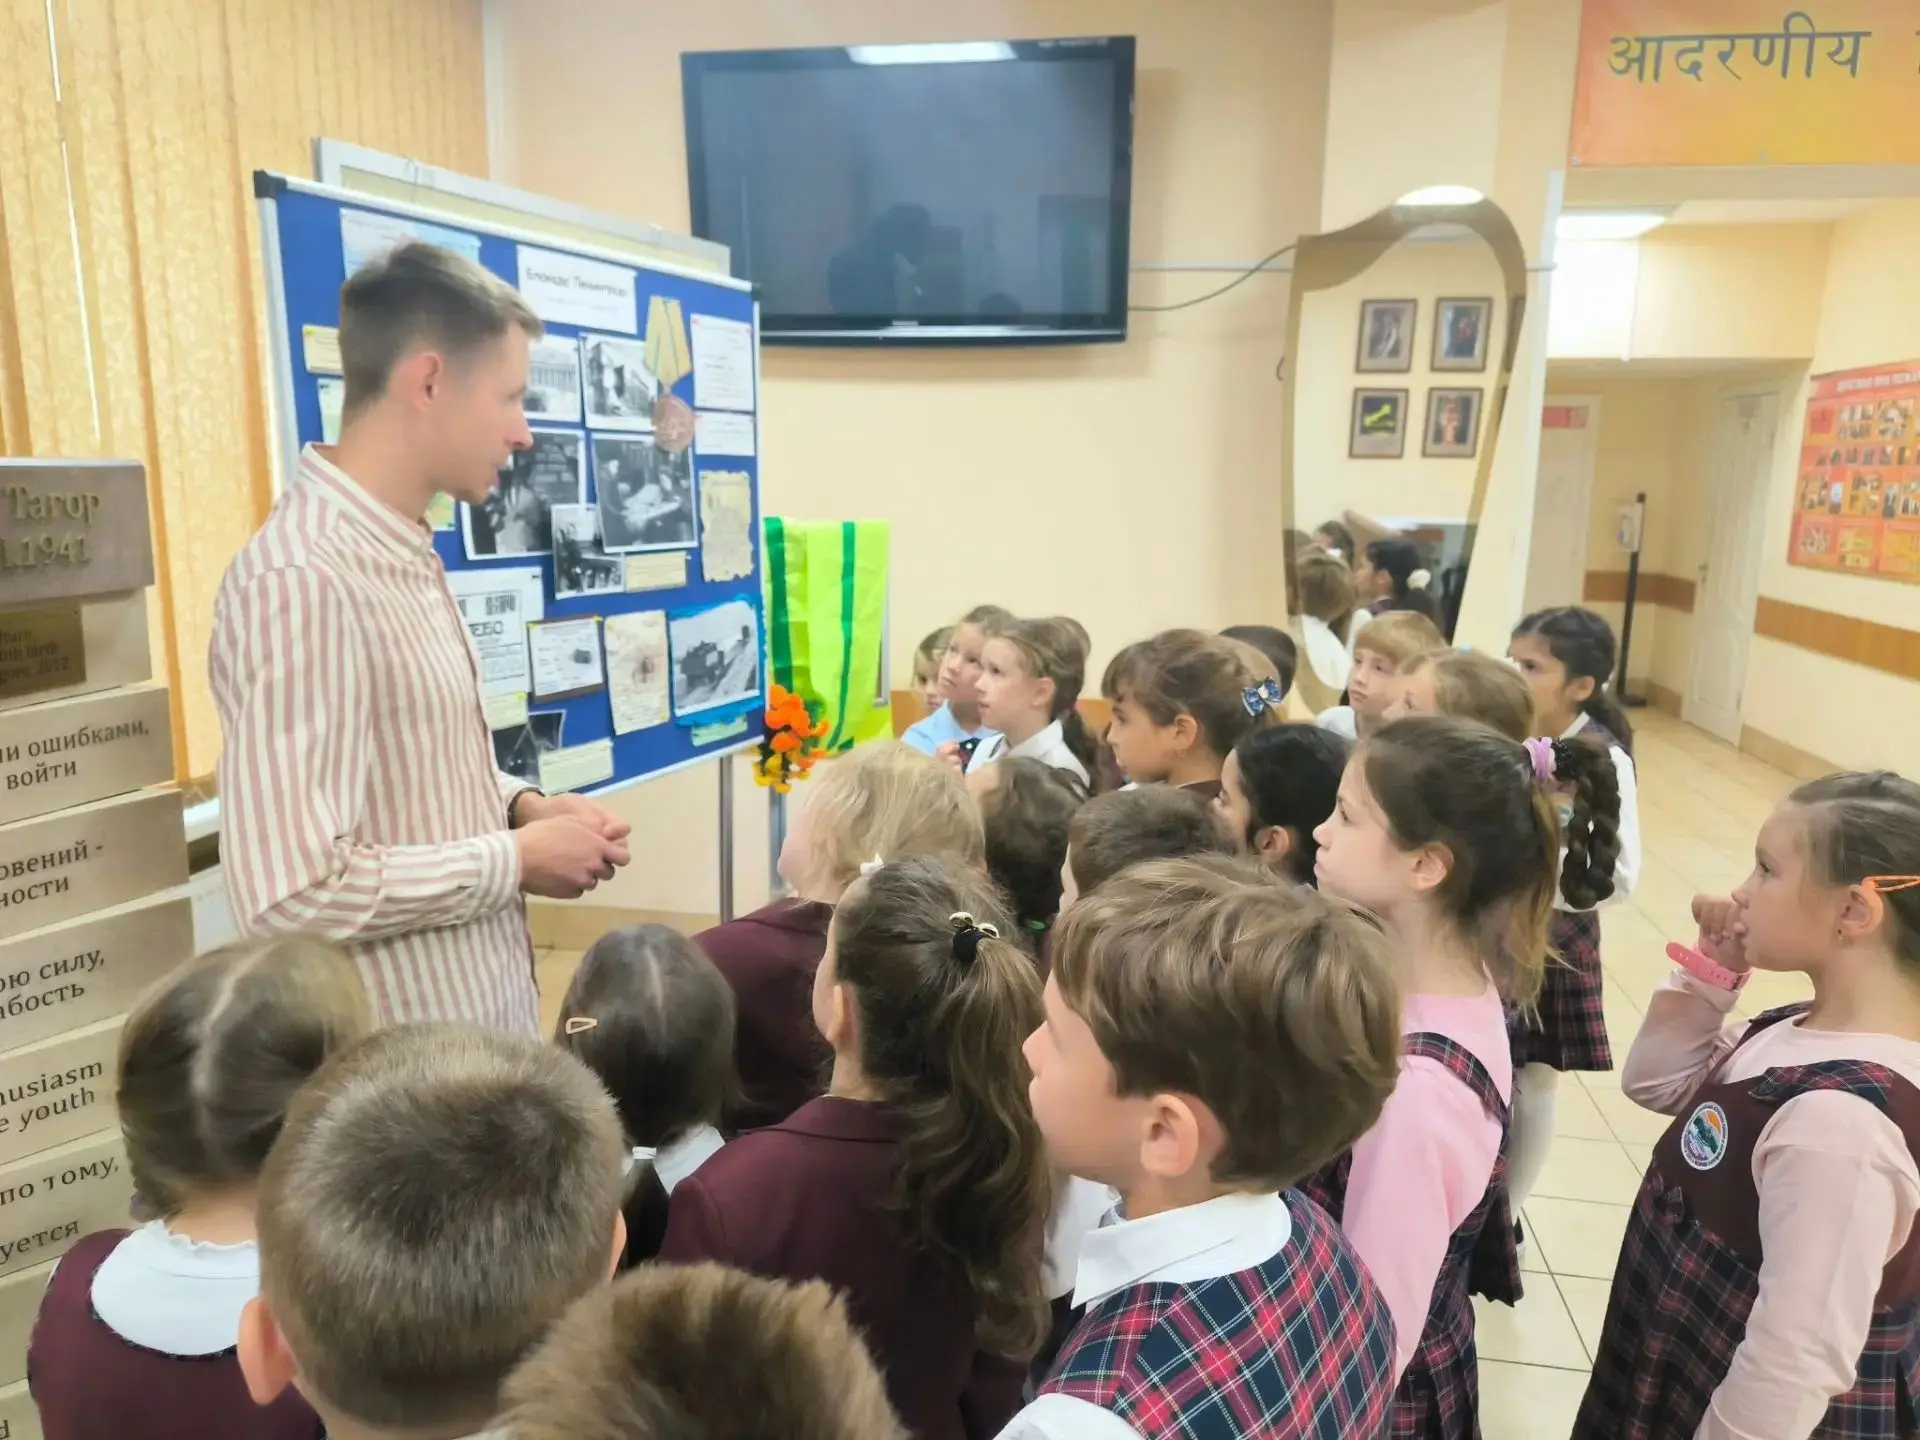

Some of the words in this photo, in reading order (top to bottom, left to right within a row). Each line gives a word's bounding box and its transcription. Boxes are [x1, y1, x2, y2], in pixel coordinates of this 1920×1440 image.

[1607, 11, 1872, 82] आदरणीय
[8, 484, 100, 529] Тагор
[0, 745, 20, 763] и
[28, 719, 150, 757] ошибками,
[6, 760, 77, 790] войти
[39, 949, 104, 980] силу,
[18, 1086, 95, 1133] youth
[0, 1183, 34, 1206] по
[42, 1157, 119, 1191] тому,
[0, 1220, 79, 1265] уется
